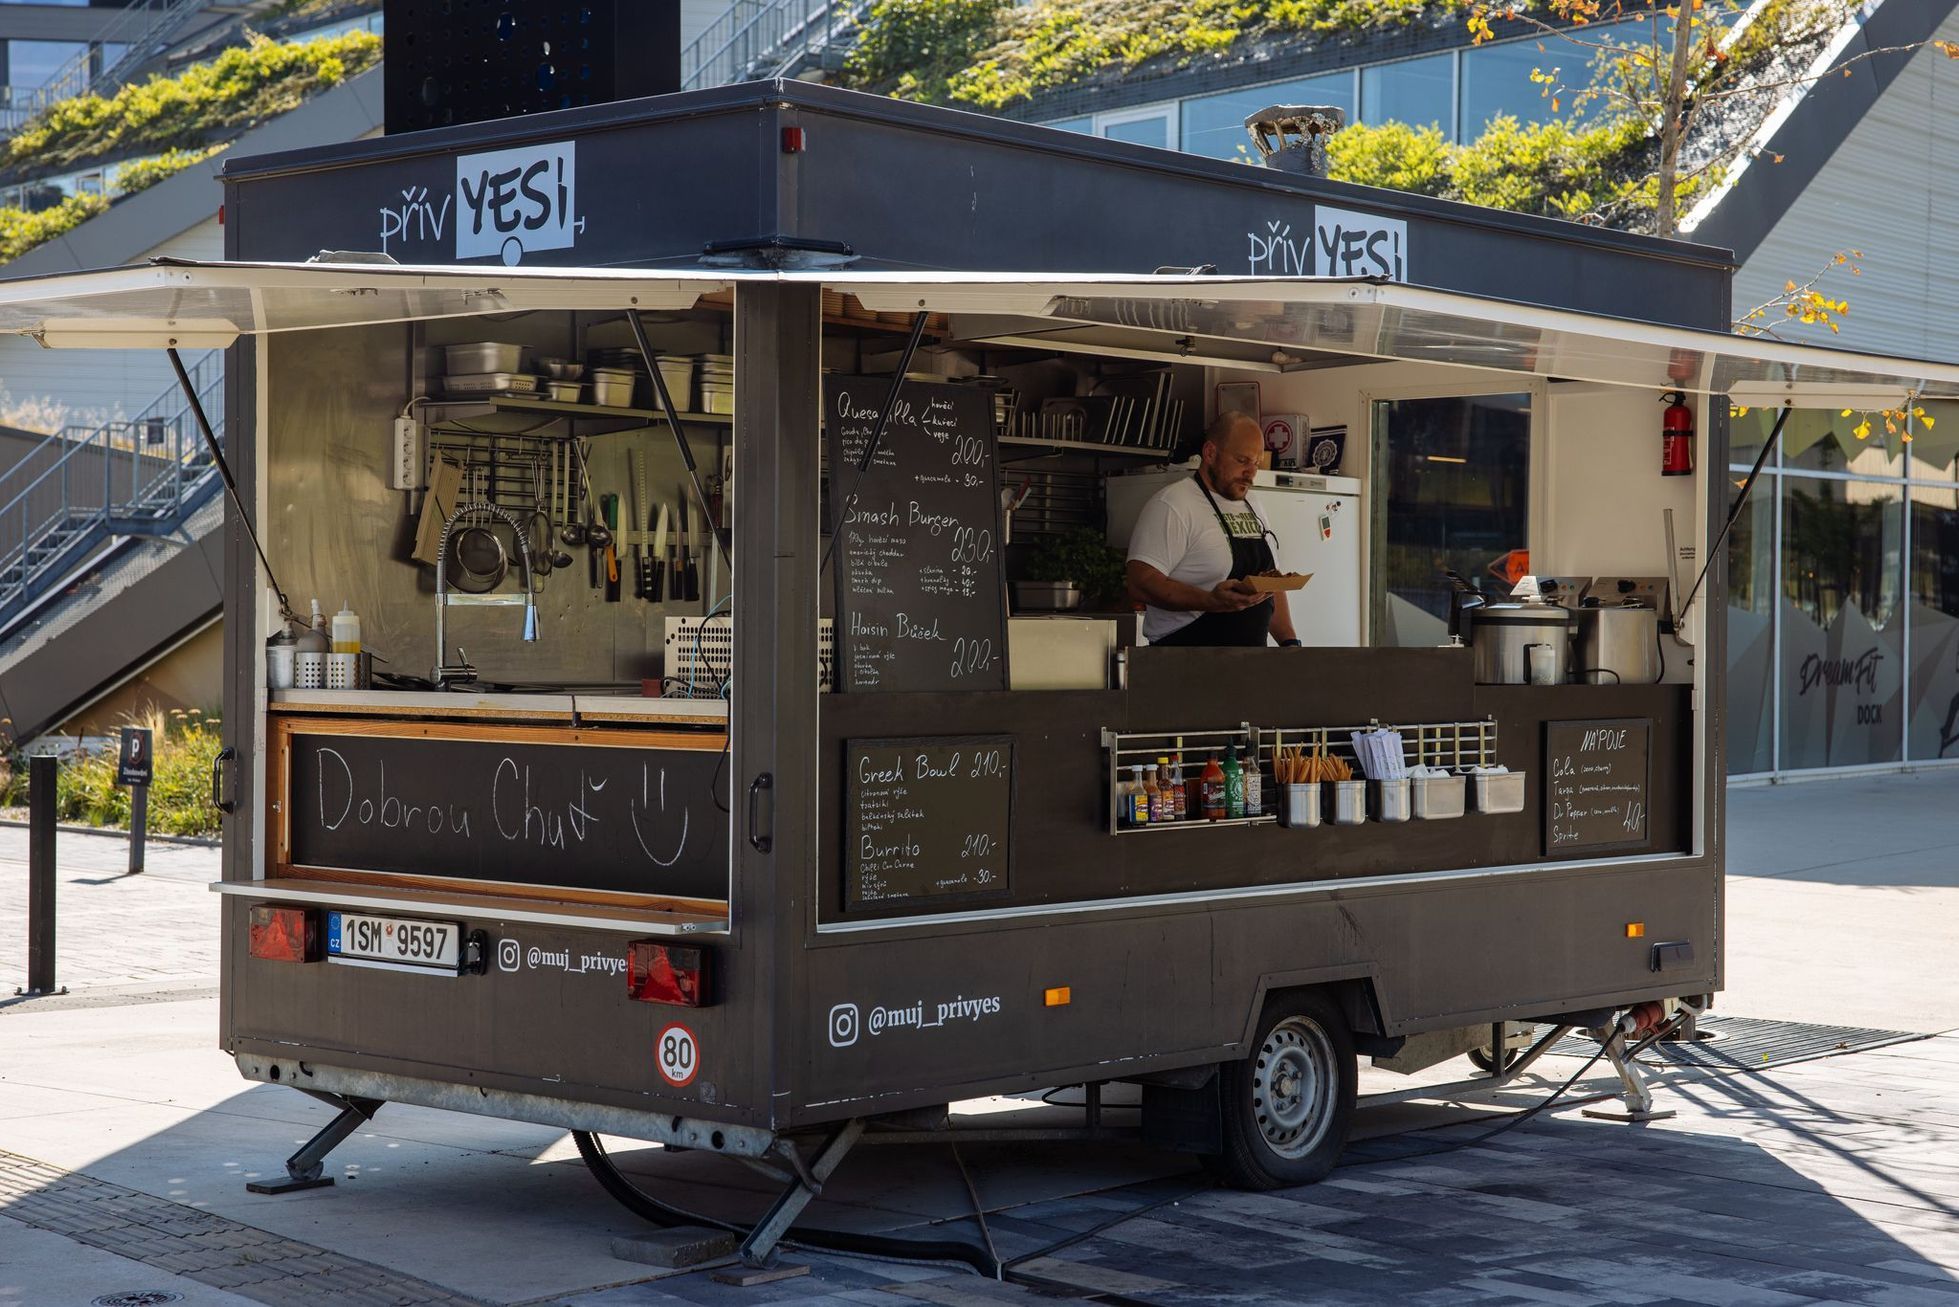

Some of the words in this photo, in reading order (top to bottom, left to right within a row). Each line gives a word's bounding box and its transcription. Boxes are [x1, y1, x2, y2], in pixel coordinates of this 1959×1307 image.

[380, 186, 451, 253] přív
[1248, 220, 1311, 276] přív
[838, 392, 917, 426] Quesailla
[952, 435, 990, 467] 200,-
[844, 494, 900, 527] Smash
[909, 501, 959, 536] Burger
[952, 527, 994, 563] 230,-
[851, 612, 888, 636] Hoisin
[951, 638, 999, 677] 200,-
[1857, 704, 1882, 725] DOCK
[859, 755, 904, 784] Greek
[915, 752, 960, 779] Bowl
[970, 750, 1007, 779] 210,-
[1553, 756, 1575, 777] Cola
[317, 748, 470, 838] Dobrou
[1553, 802, 1564, 820] Dr
[861, 833, 920, 860] Burrito
[961, 834, 997, 858] 210,-
[1553, 825, 1579, 843] Sprite
[330, 938, 341, 948] CZ
[346, 919, 382, 953] 1SM
[397, 923, 448, 960] 9597
[527, 946, 629, 976] @muj_privye
[868, 995, 1001, 1035] @muj_privyes
[663, 1035, 692, 1069] 80
[671, 1068, 684, 1079] km
